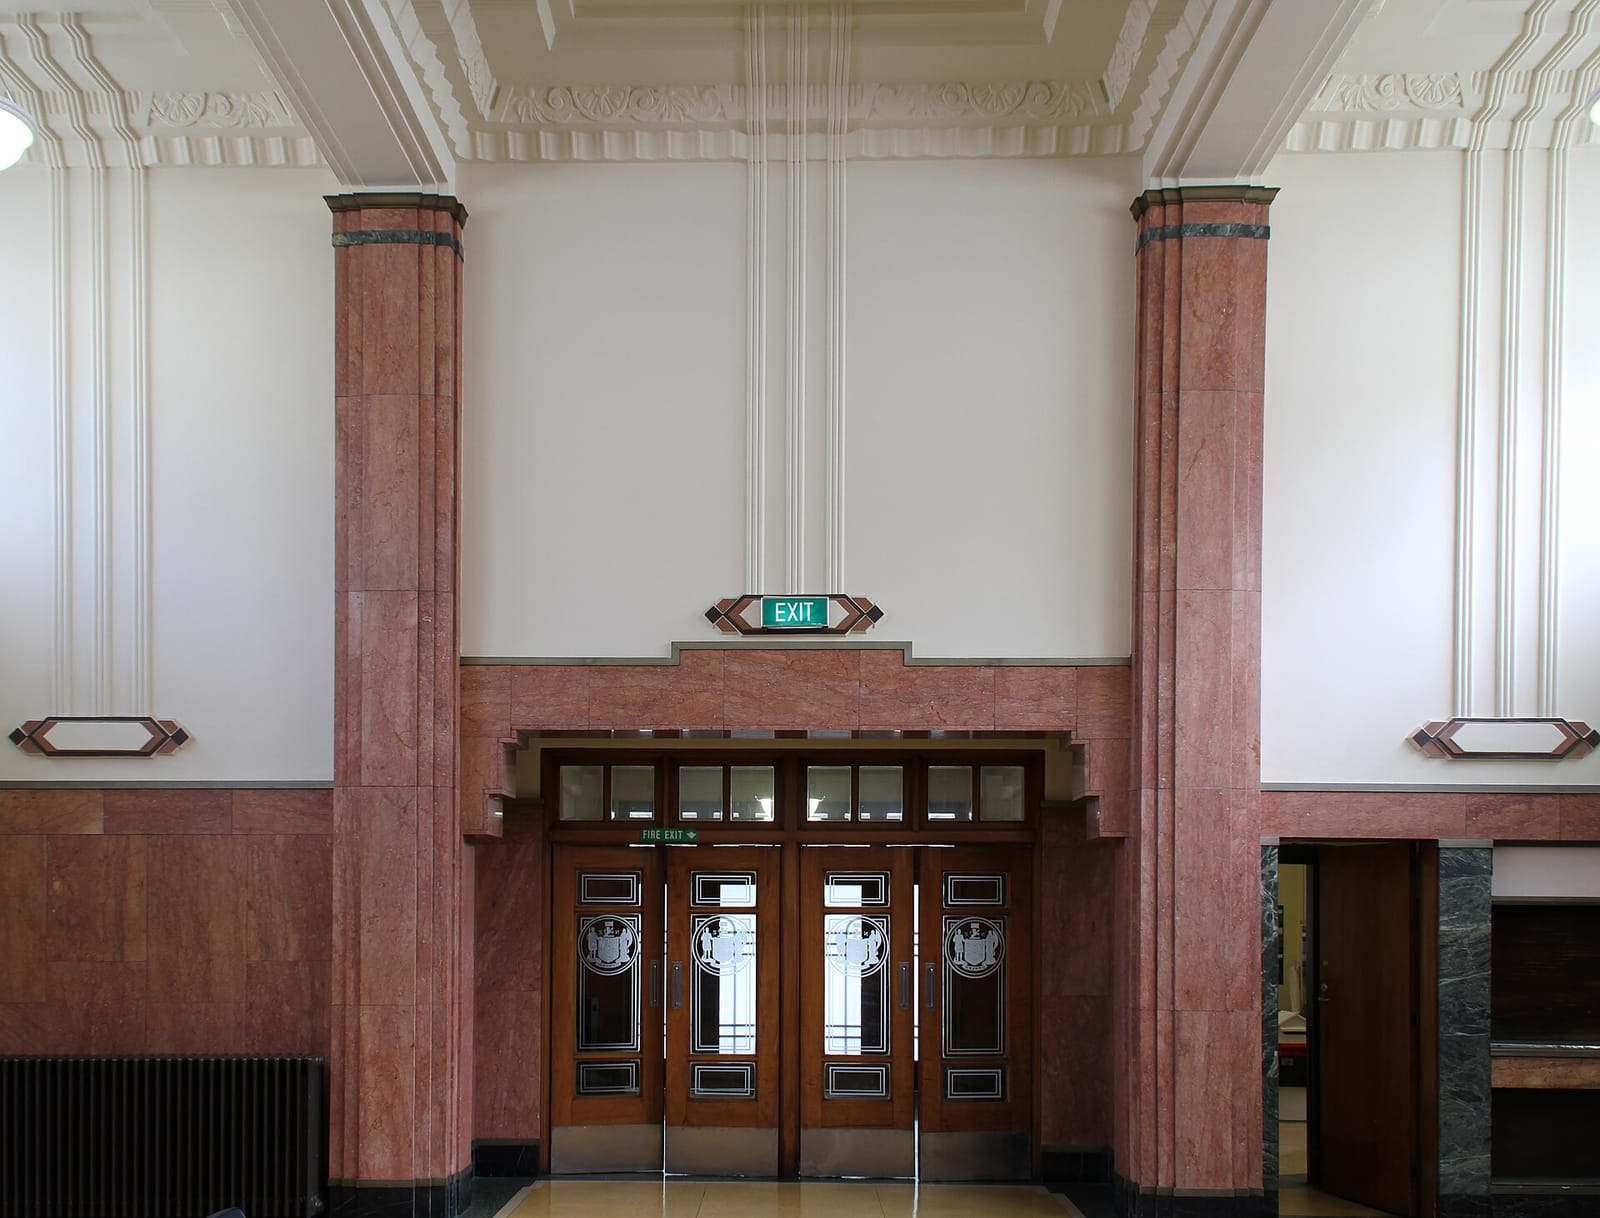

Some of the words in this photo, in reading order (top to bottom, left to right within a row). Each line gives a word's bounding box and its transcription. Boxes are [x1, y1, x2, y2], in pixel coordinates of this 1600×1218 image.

[775, 602, 814, 622] EXIT
[643, 830, 660, 839] FIRE
[665, 830, 683, 839] EXIT
